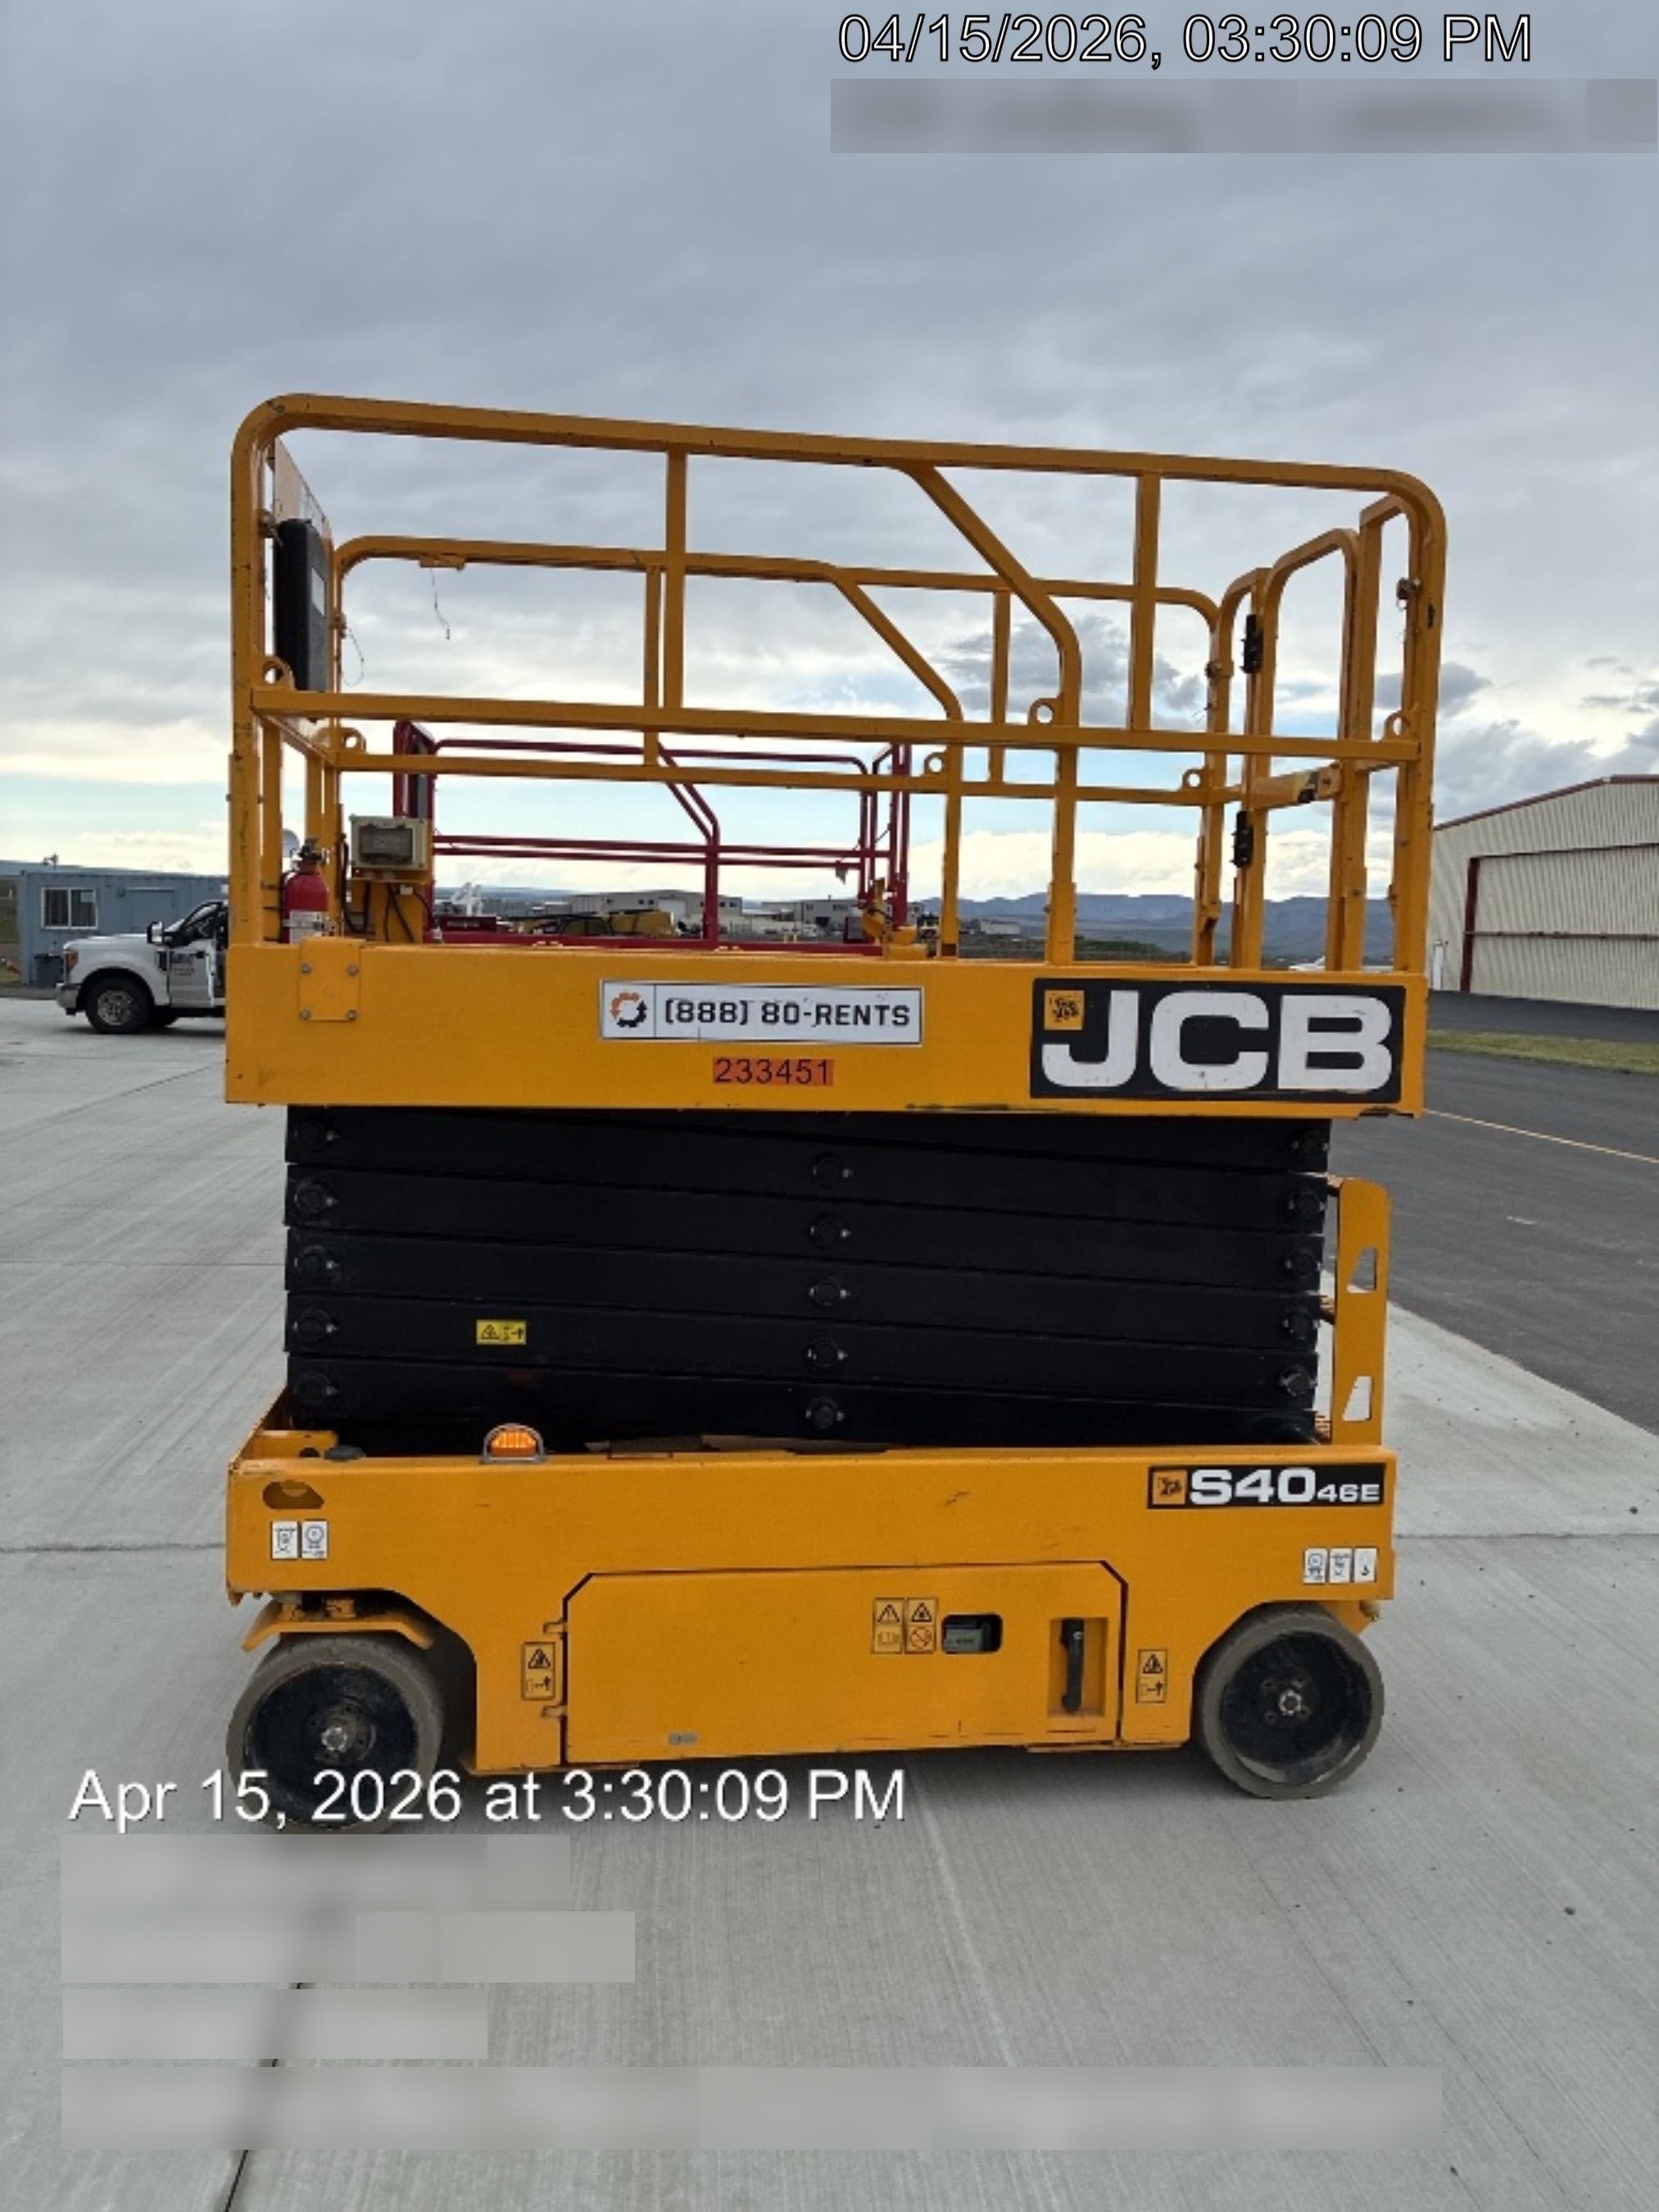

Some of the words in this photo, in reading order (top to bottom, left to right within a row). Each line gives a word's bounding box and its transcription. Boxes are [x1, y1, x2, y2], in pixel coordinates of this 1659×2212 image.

[761, 1002, 910, 1026] 80-RENTS
[1041, 990, 1392, 1092] JCB
[714, 1058, 829, 1083] 233451
